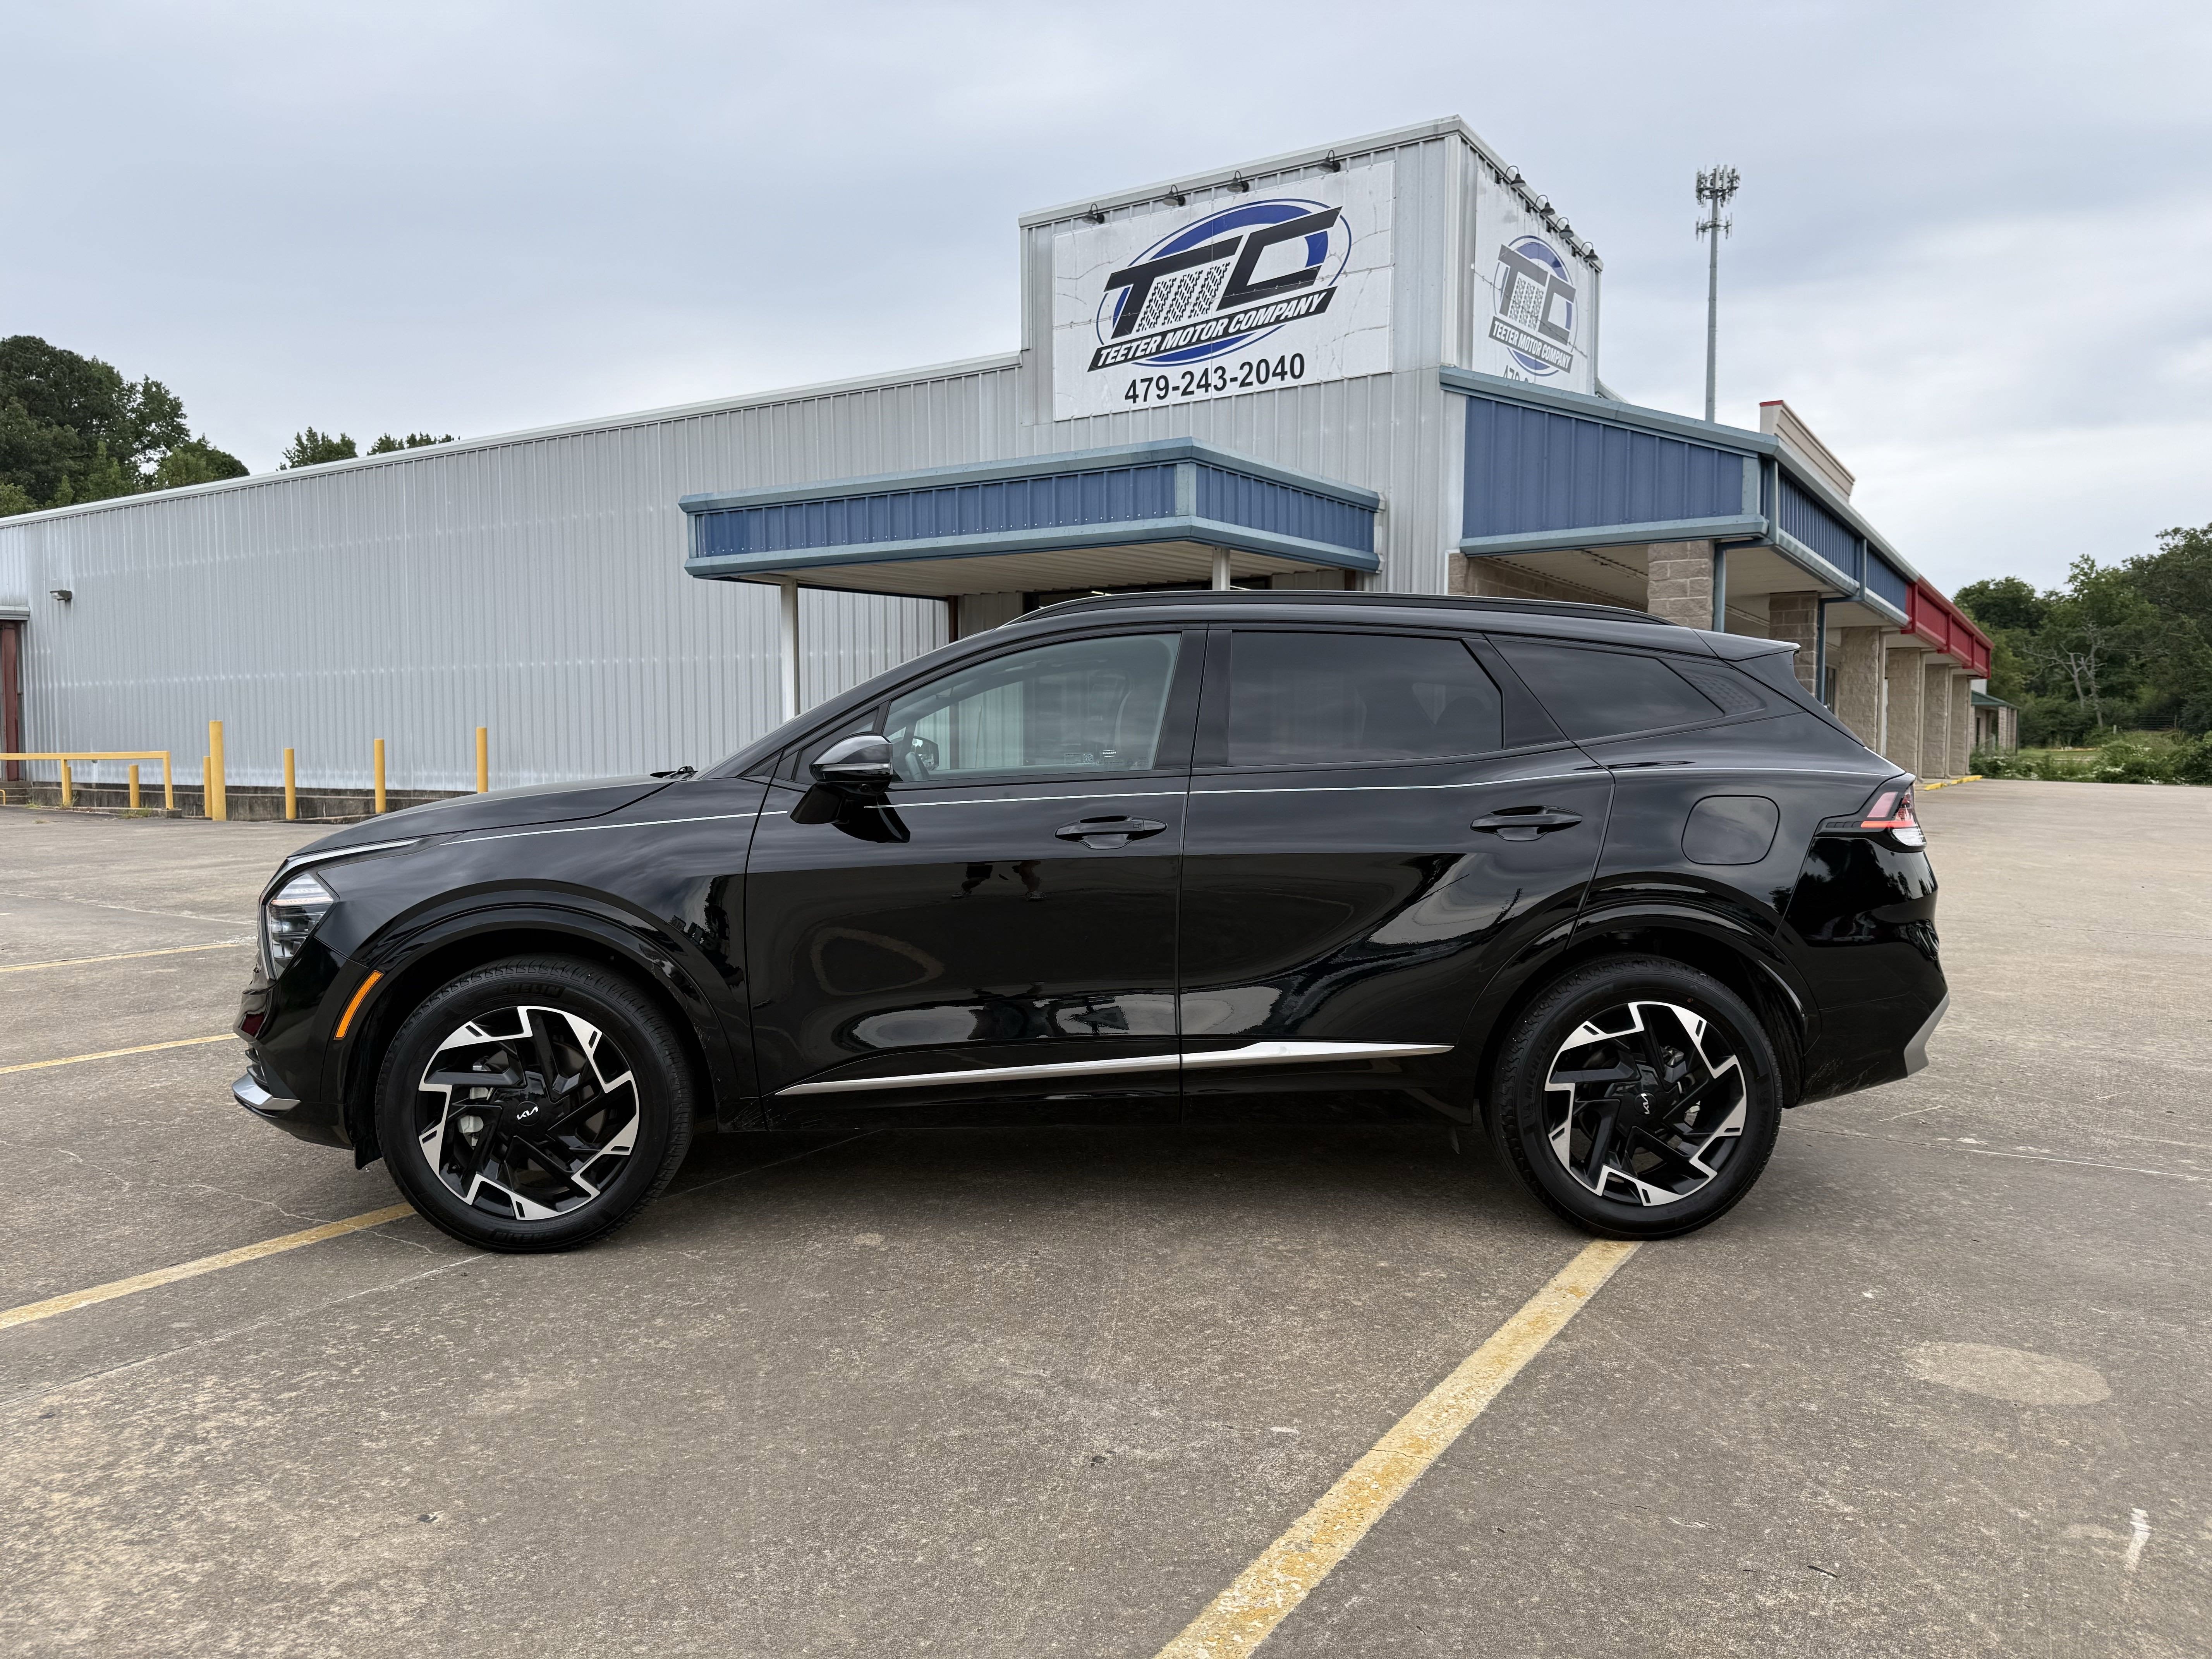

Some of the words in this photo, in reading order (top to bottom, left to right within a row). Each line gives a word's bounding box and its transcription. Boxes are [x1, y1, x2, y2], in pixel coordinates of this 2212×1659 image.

[1097, 335, 1162, 366] TEETER
[1160, 318, 1228, 350] MOTOR
[1228, 292, 1327, 333] COMPANY
[1493, 320, 1519, 346] TEETER
[1517, 333, 1542, 356] MOTOR
[1541, 344, 1571, 369] COMPANY
[1125, 353, 1305, 404] 479-243-2040
